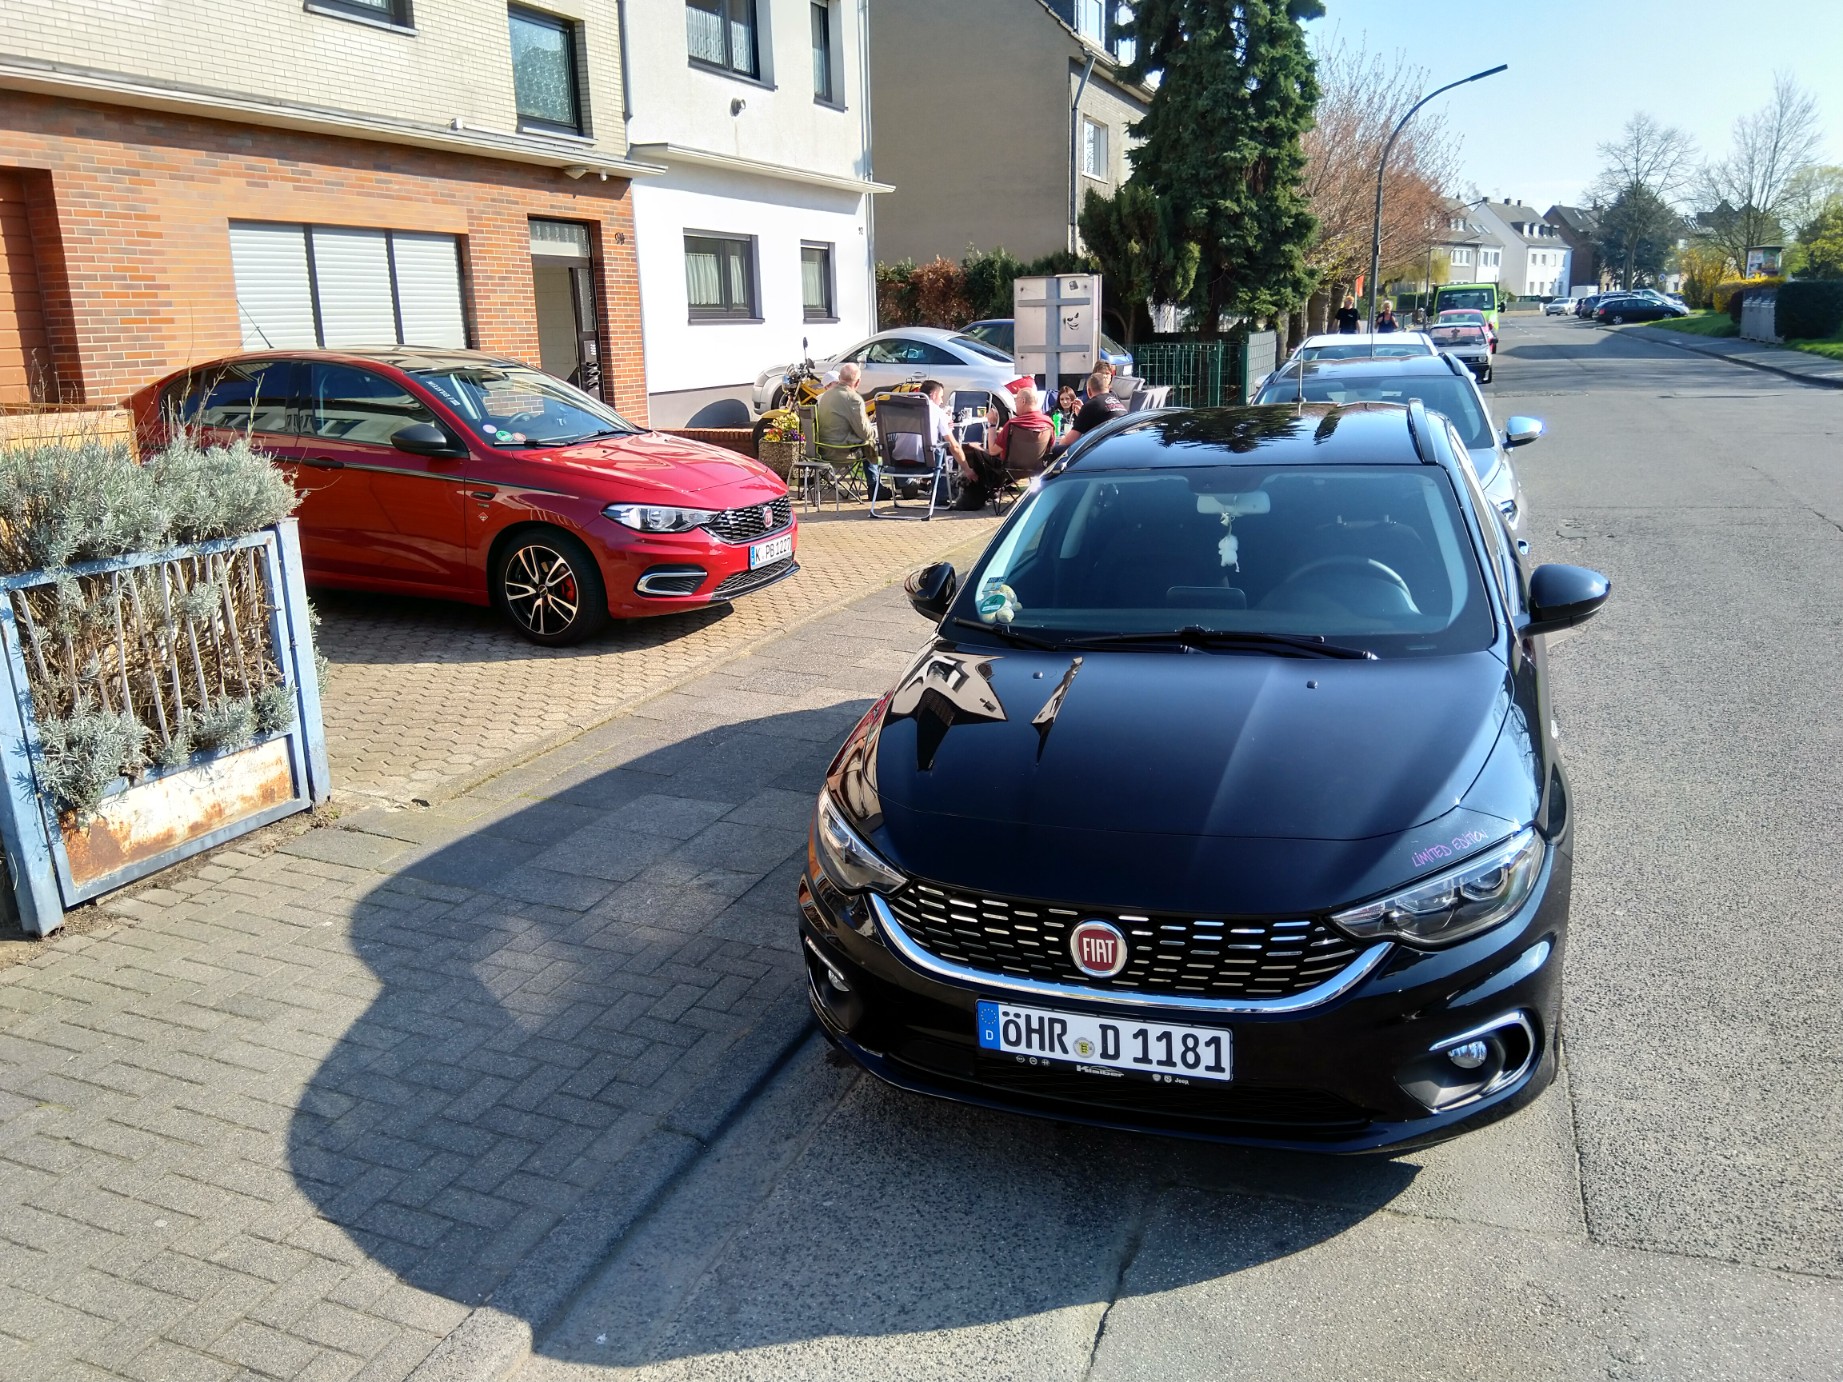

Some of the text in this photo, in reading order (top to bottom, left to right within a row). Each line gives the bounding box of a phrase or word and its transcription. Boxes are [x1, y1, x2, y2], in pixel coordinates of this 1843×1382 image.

[755, 547, 761, 562] K
[765, 543, 775, 560] PB
[1082, 937, 1115, 964] FIAT
[985, 1029, 994, 1041] D
[1002, 1010, 1226, 1074] ÖHR D 1181
